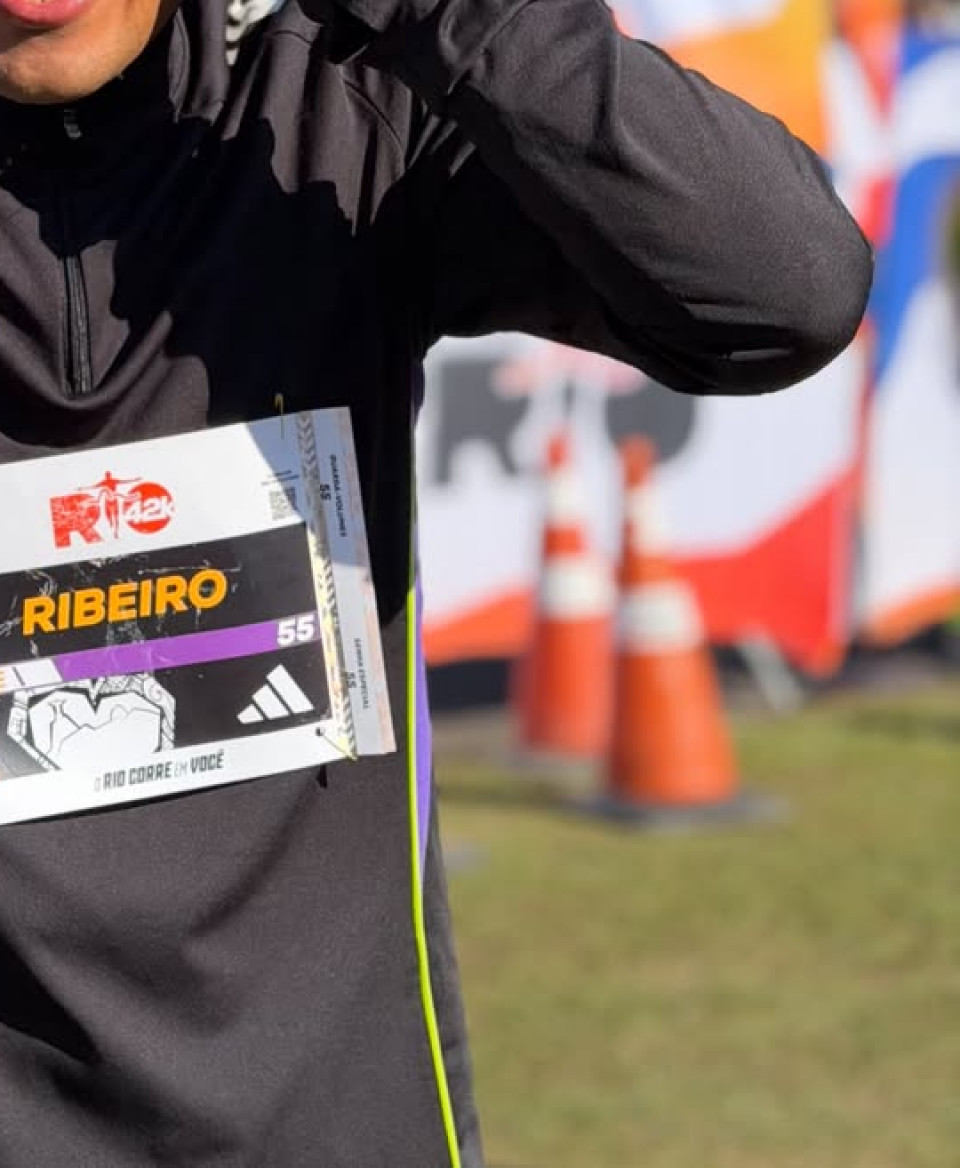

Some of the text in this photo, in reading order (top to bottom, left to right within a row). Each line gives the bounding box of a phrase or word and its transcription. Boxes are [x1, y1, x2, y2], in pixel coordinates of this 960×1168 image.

[319, 483, 332, 501] 55
[21, 568, 228, 636] RIBEIRO
[276, 614, 317, 647] 55
[103, 767, 127, 791] RIO
[128, 760, 173, 785] CORRE
